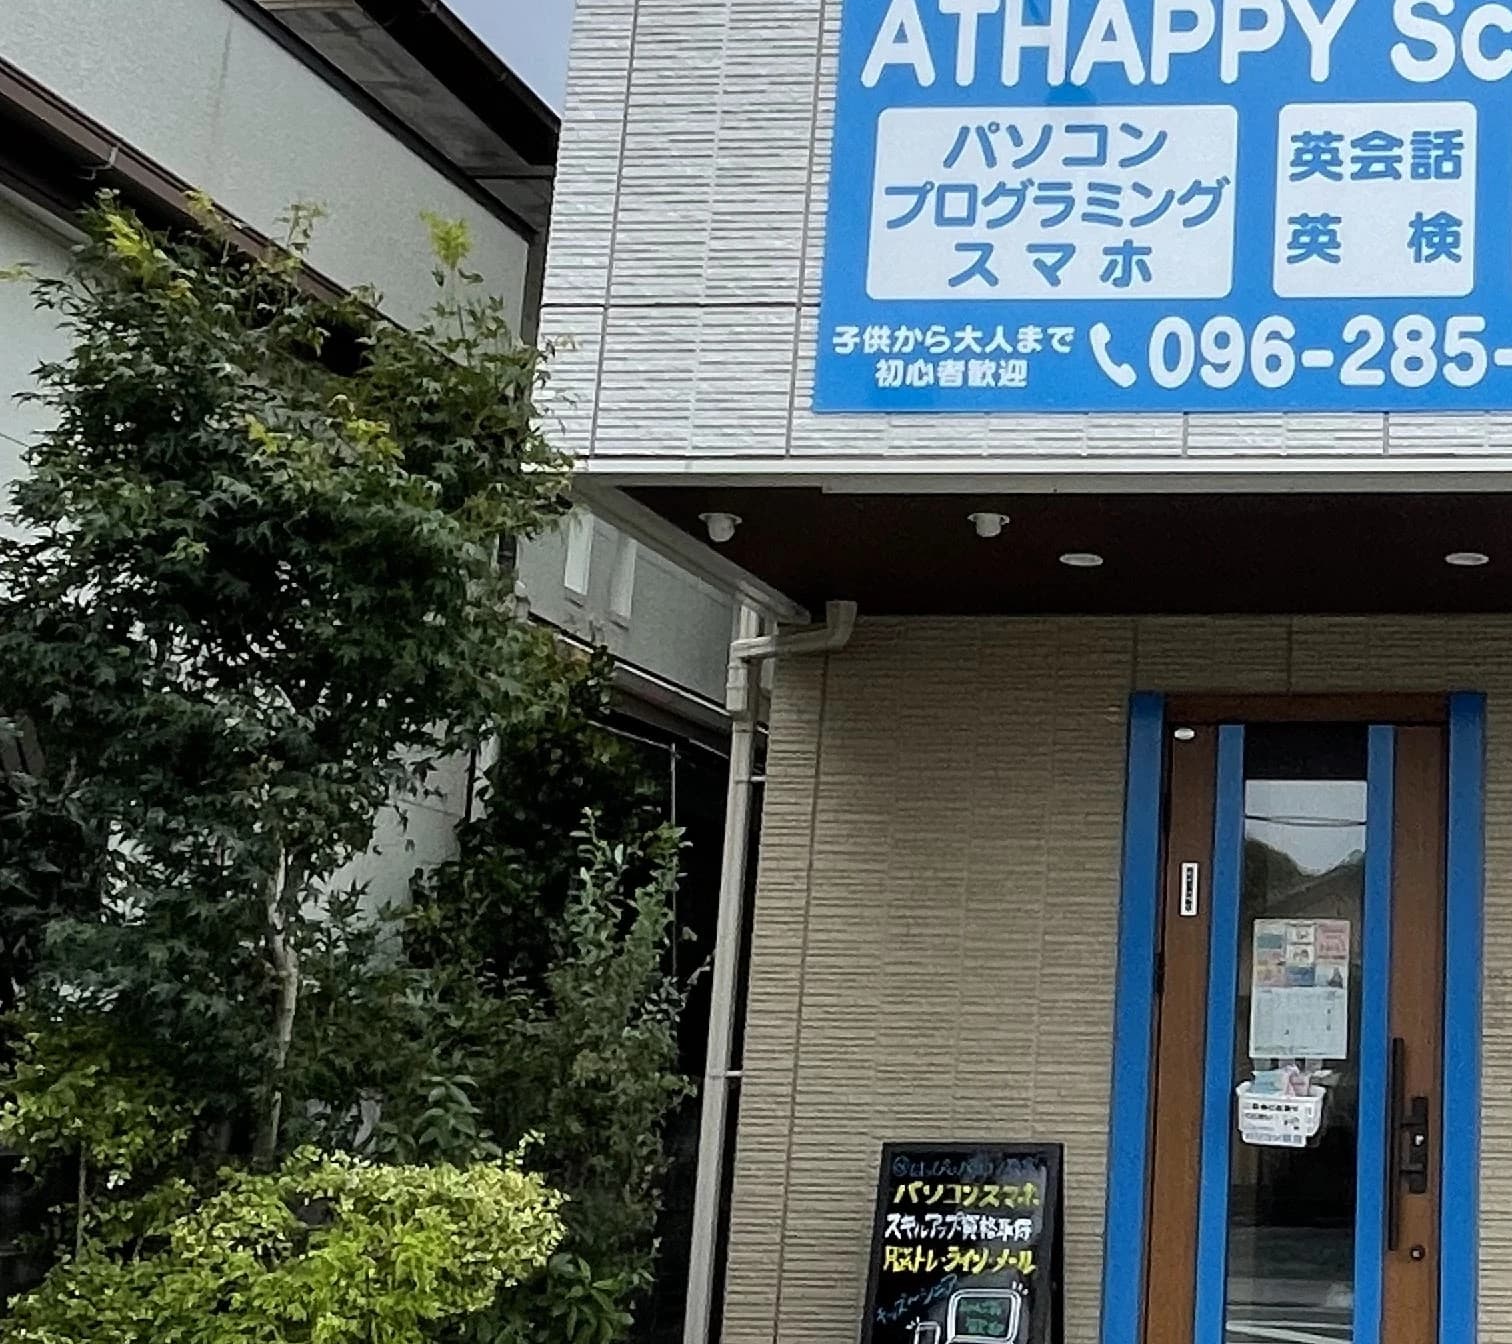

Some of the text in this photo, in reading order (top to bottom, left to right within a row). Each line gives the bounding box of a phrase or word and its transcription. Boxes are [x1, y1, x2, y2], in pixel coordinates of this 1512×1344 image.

[943, 122, 1169, 170] パソコン
[1288, 128, 1465, 182] 英会話
[883, 176, 1232, 230] プログラミング
[831, 324, 1076, 356] 子供から大人まで
[873, 356, 1029, 390] 初心者歓迎
